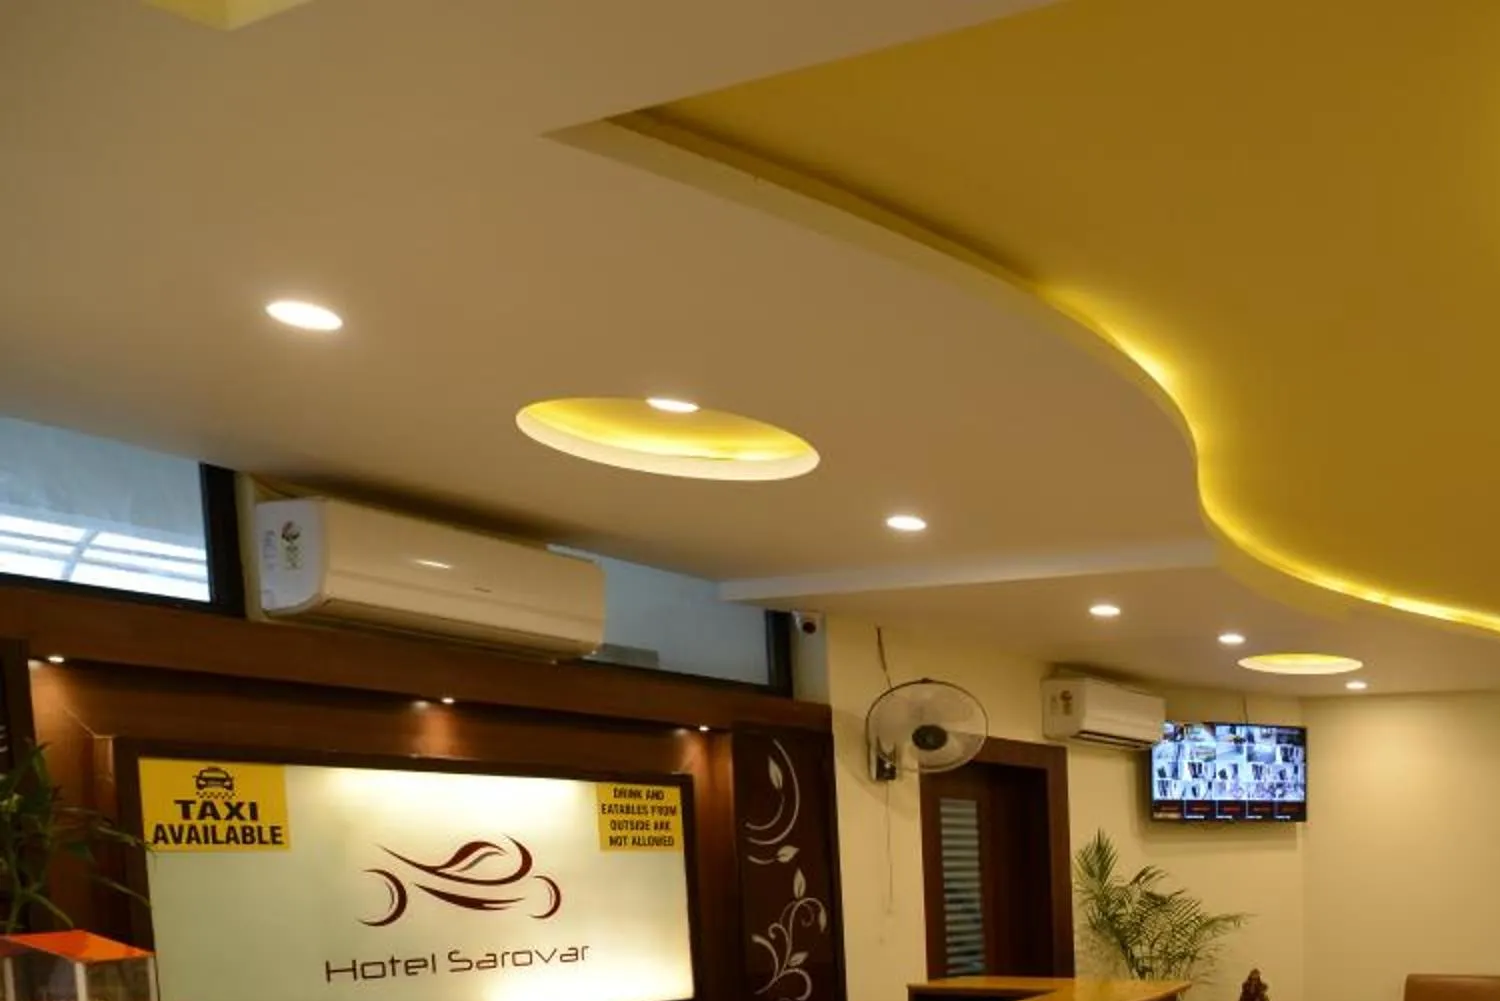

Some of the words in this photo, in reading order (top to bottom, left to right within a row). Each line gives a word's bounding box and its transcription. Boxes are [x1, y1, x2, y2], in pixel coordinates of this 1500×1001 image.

[612, 787, 643, 799] DRINK
[645, 788, 665, 801] AND
[174, 799, 259, 821] TAXI
[600, 803, 649, 815] EATABLES
[650, 804, 677, 817] FROM
[610, 819, 650, 831] OUTSIDE
[152, 823, 285, 846] AVAILABLE
[608, 835, 627, 847] NOT
[631, 834, 675, 847] ALLOWED
[324, 952, 437, 983] Hotel
[447, 945, 590, 973] Sarovar
